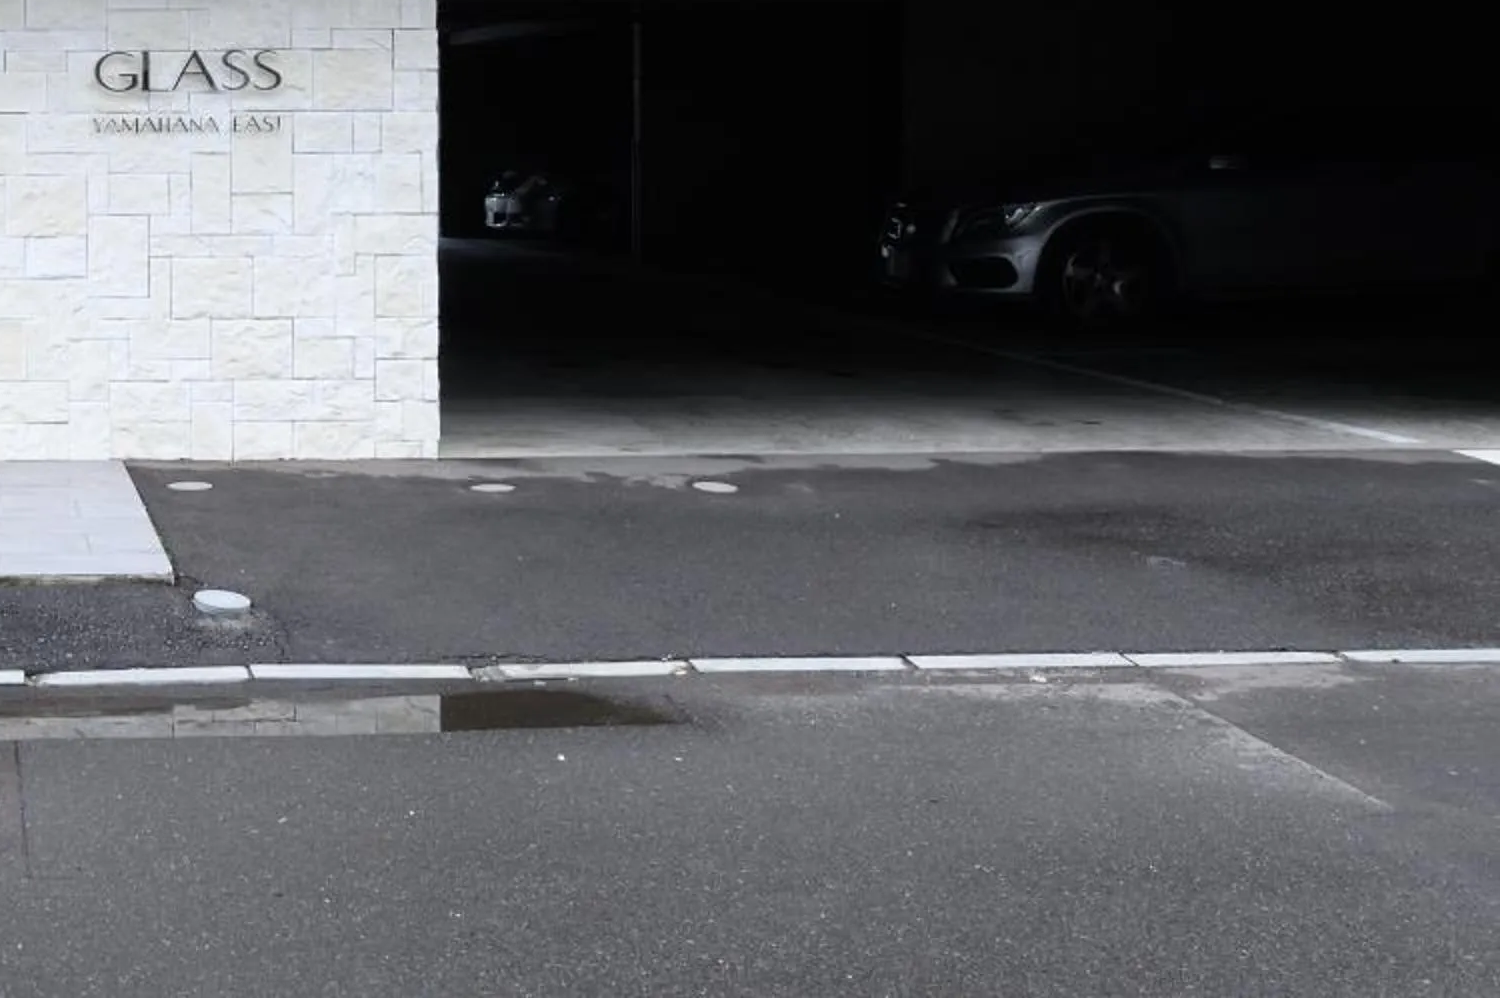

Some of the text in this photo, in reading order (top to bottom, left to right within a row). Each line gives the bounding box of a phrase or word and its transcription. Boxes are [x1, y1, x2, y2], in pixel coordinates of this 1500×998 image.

[94, 50, 282, 92] GLASS
[92, 115, 282, 134] YAMAHANA EAST
